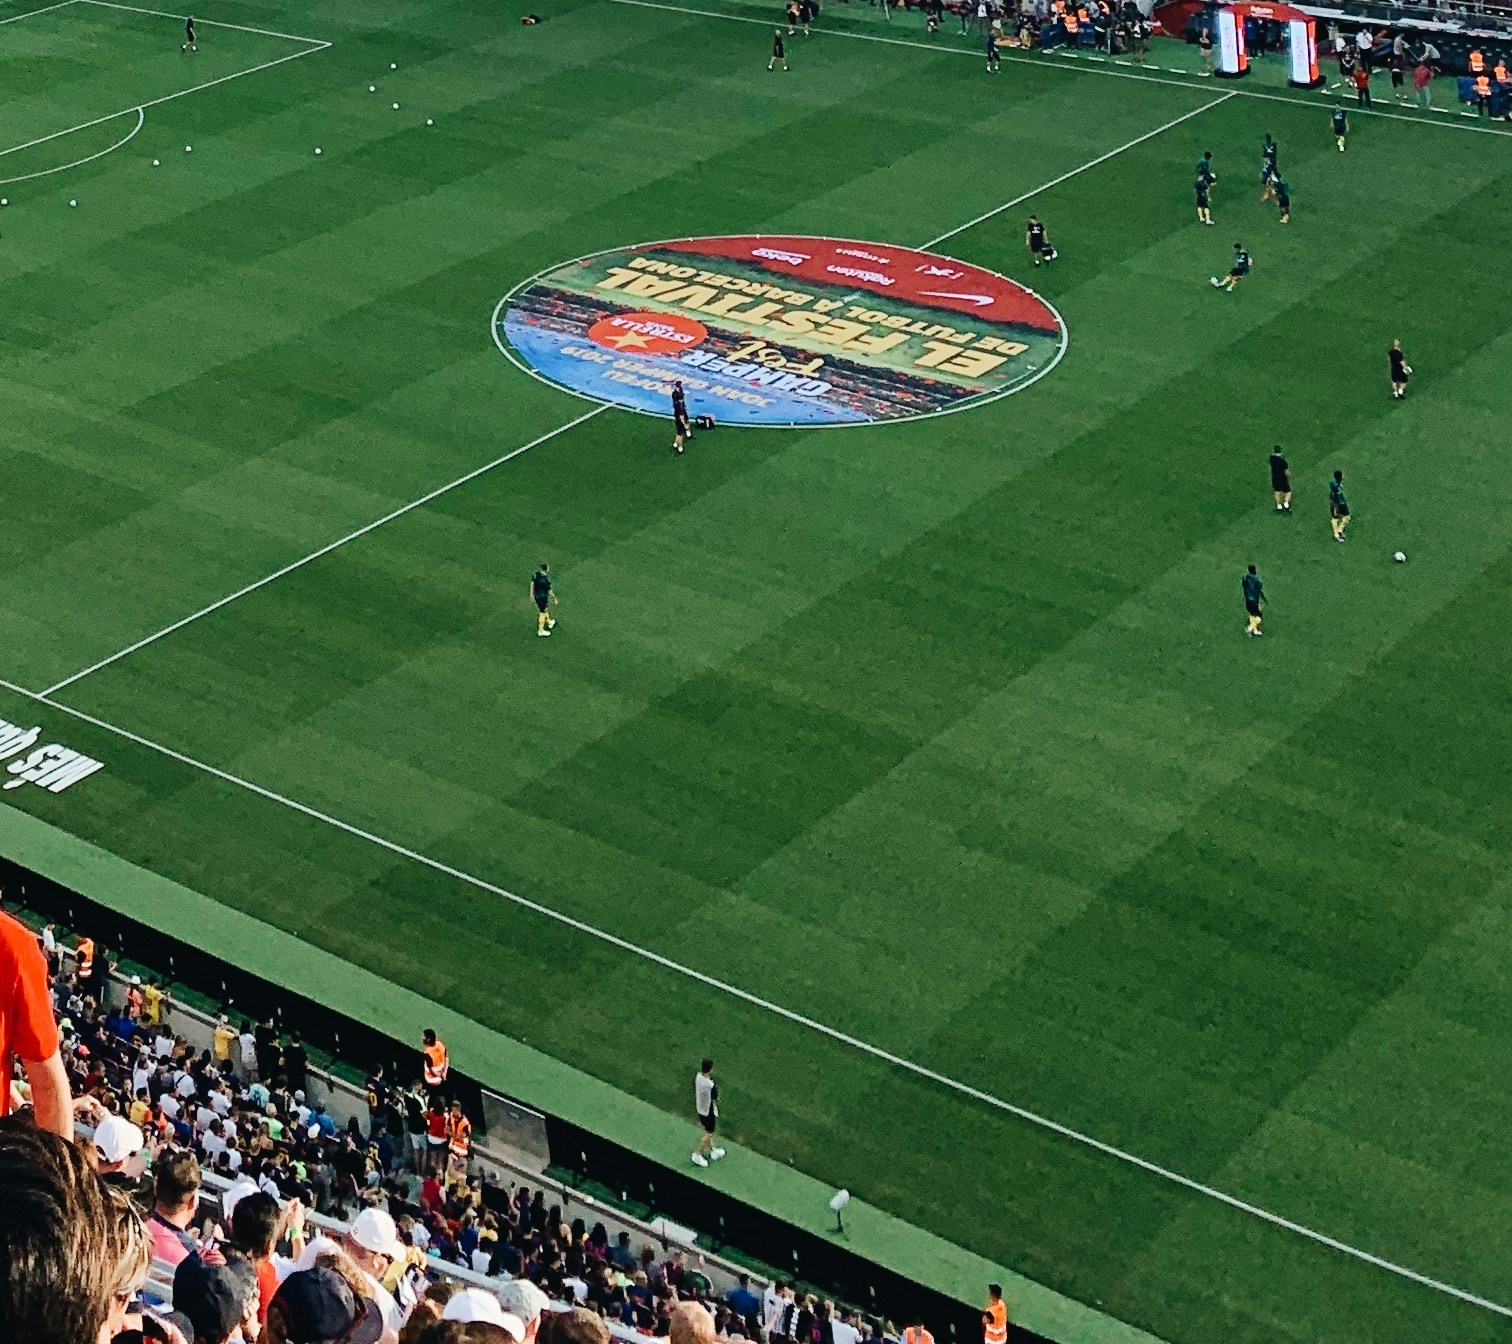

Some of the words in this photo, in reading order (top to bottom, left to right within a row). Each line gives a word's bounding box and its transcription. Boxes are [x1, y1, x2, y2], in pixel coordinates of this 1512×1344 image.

[627, 256, 814, 305] BARCELONA
[595, 267, 911, 355] FESTIVAL
[610, 317, 696, 345] ESTRELLA
[844, 305, 978, 345] FUTBOL
[913, 340, 1008, 379] EL
[971, 335, 1030, 357] DE
[680, 349, 834, 397] GAMPER
[2, 743, 105, 794] MÉS
